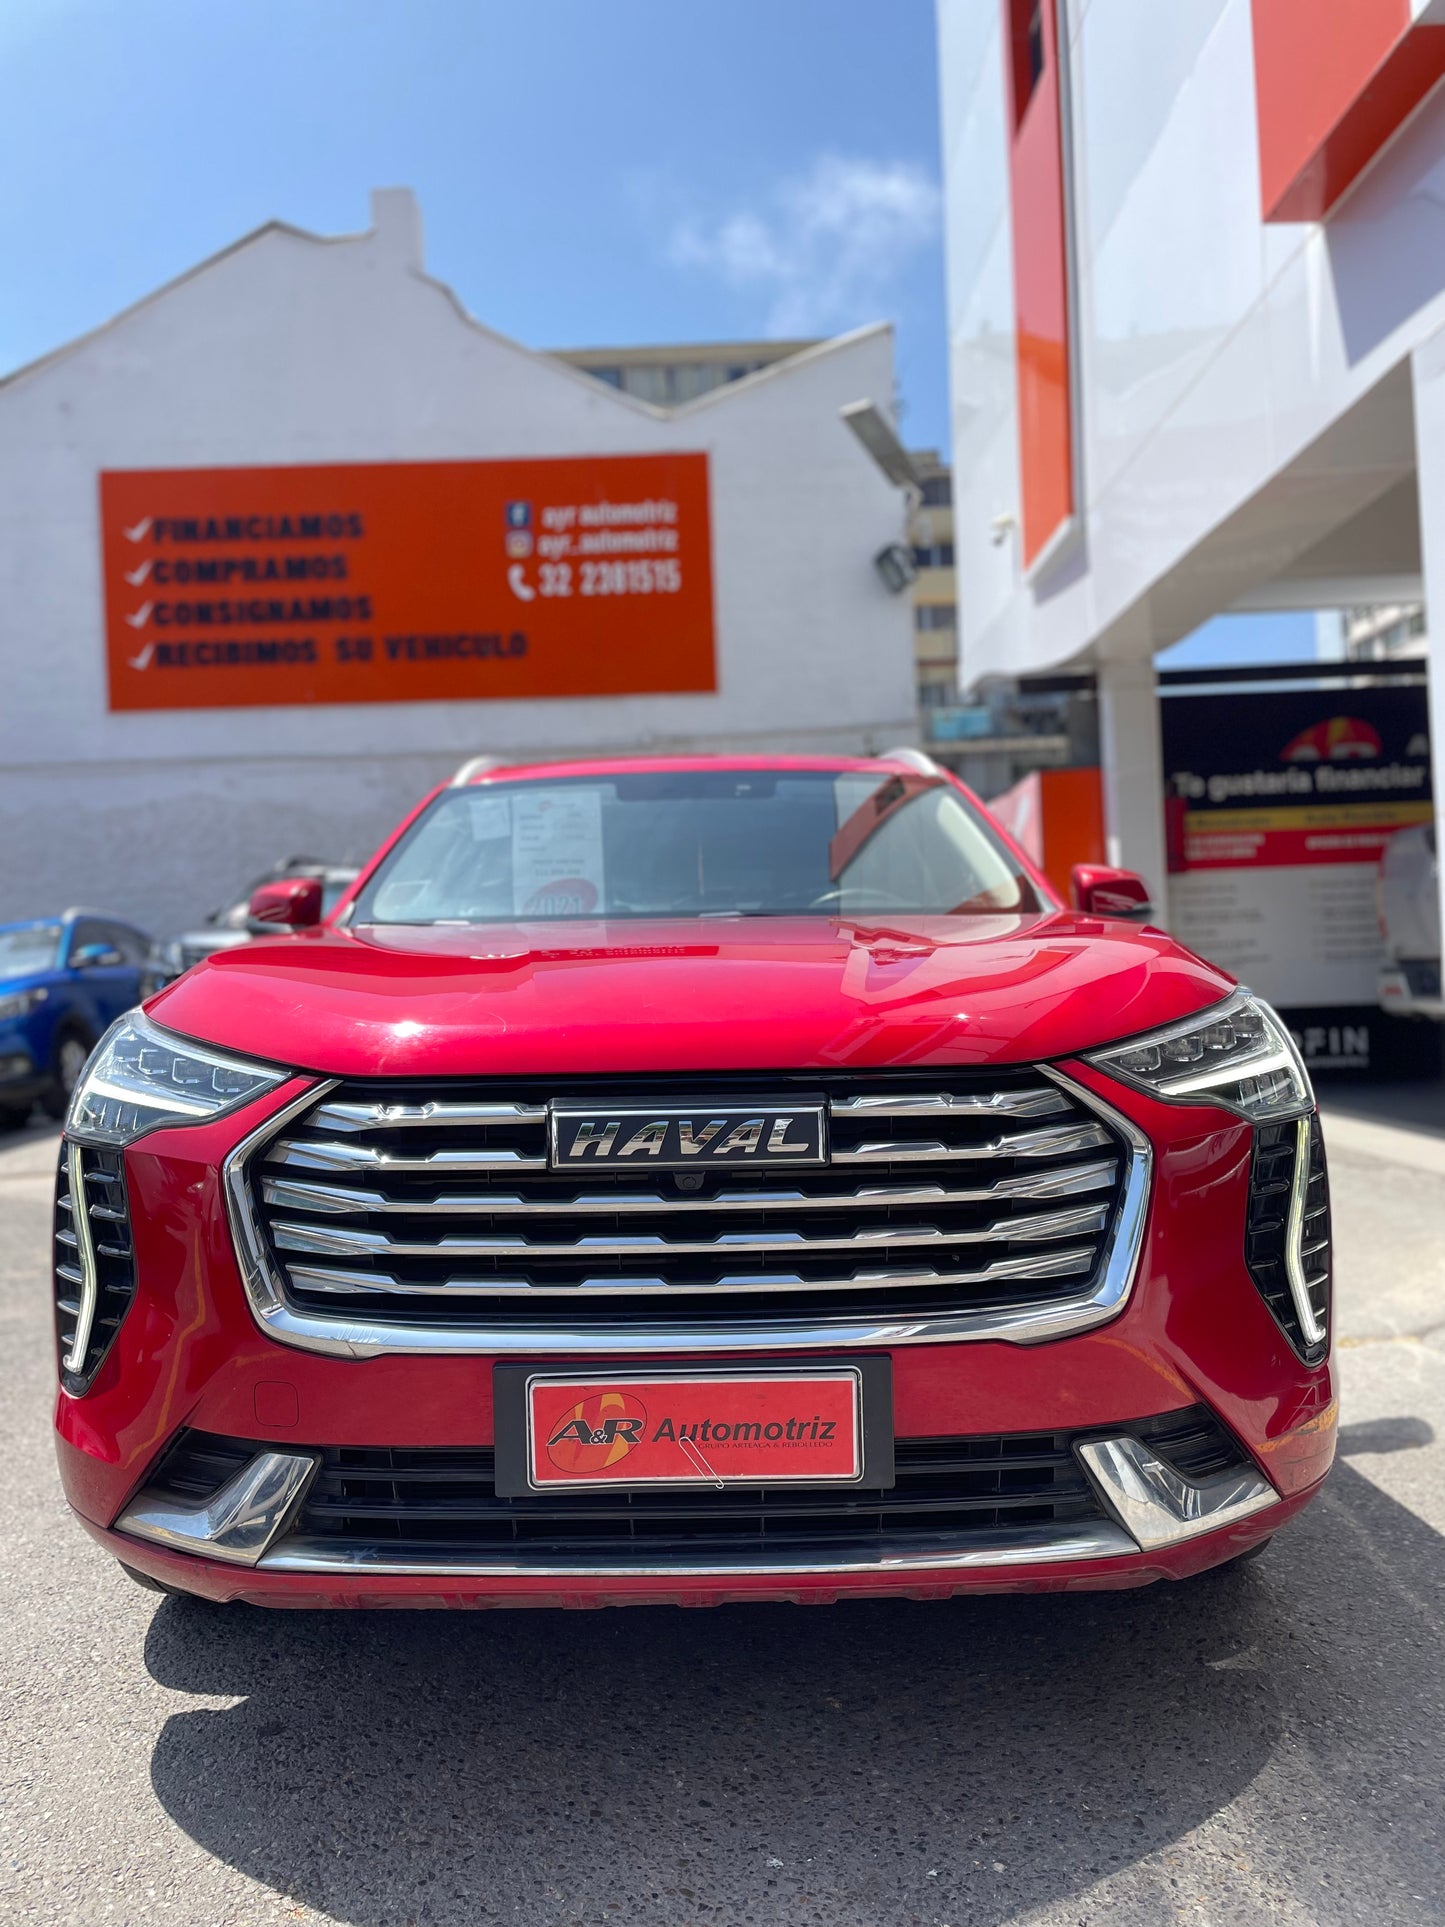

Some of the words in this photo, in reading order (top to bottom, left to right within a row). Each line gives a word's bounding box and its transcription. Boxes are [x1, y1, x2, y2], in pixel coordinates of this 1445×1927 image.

[153, 512, 363, 543] FINANCIAMOS
[578, 499, 679, 527] automotriz
[153, 555, 347, 585] COMPRAMOS
[538, 562, 573, 597] 32
[153, 595, 373, 627] CONSIGNAMOS
[155, 637, 317, 668] RECIBIMOS
[335, 635, 374, 662] SU
[384, 630, 529, 662] VEHICULO
[1173, 771, 1206, 798] Te
[1315, 762, 1426, 791] financiar
[569, 1118, 809, 1157] HAVAL
[546, 1418, 645, 1446] A&R
[651, 1415, 837, 1443] Automotriz
[698, 1441, 730, 1449] GRUPO
[732, 1441, 771, 1449] ARTEAGA
[782, 1440, 833, 1448] REBOLLEDO
